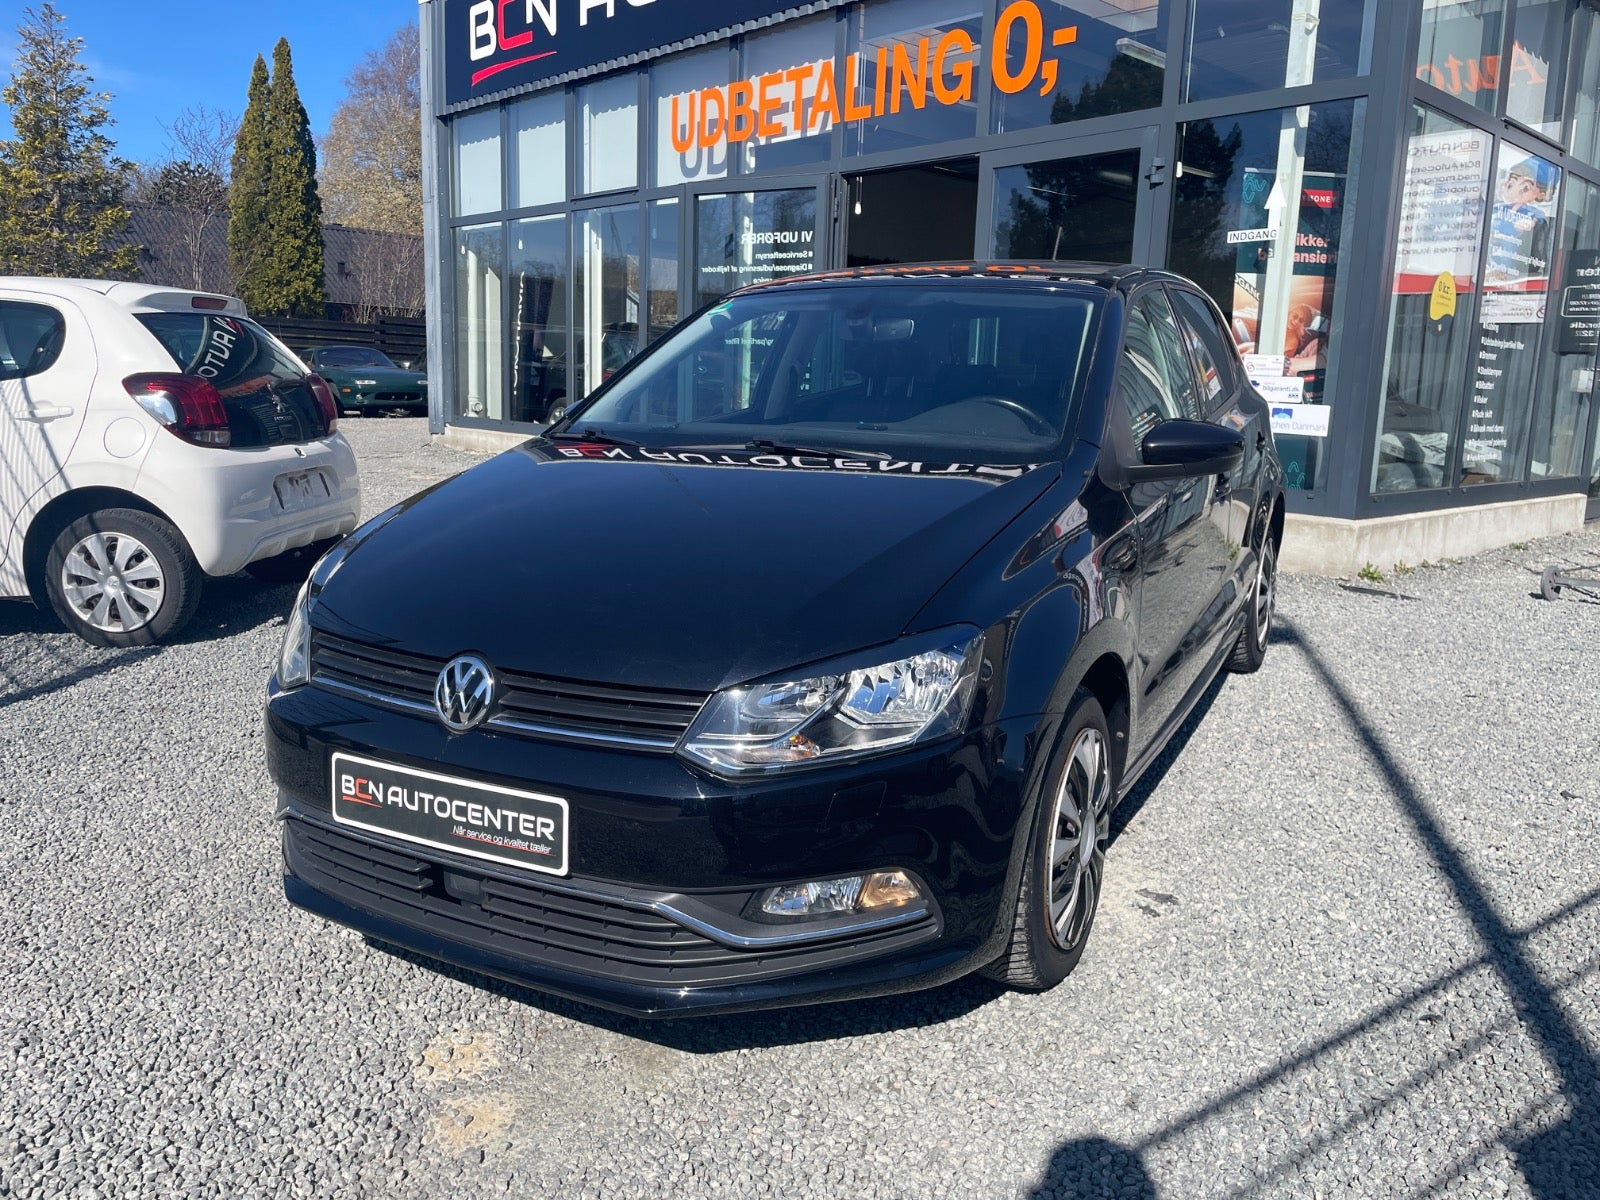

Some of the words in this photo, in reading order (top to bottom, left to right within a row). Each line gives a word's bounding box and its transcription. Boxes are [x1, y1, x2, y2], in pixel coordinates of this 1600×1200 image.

[469, 0, 558, 61] BCN
[671, 28, 973, 153] UDBETALING
[991, 0, 1077, 97] 0,-
[1229, 229, 1278, 242] INDGANG
[1296, 233, 1329, 248] ikker
[1292, 421, 1327, 433] Danmark
[341, 773, 383, 803] BCN
[386, 785, 556, 841] AUTOCENTER
[452, 824, 466, 836] Når
[466, 829, 492, 842] service
[492, 834, 503, 847] og
[503, 836, 529, 850] kvalitet
[529, 842, 552, 855] tæller
